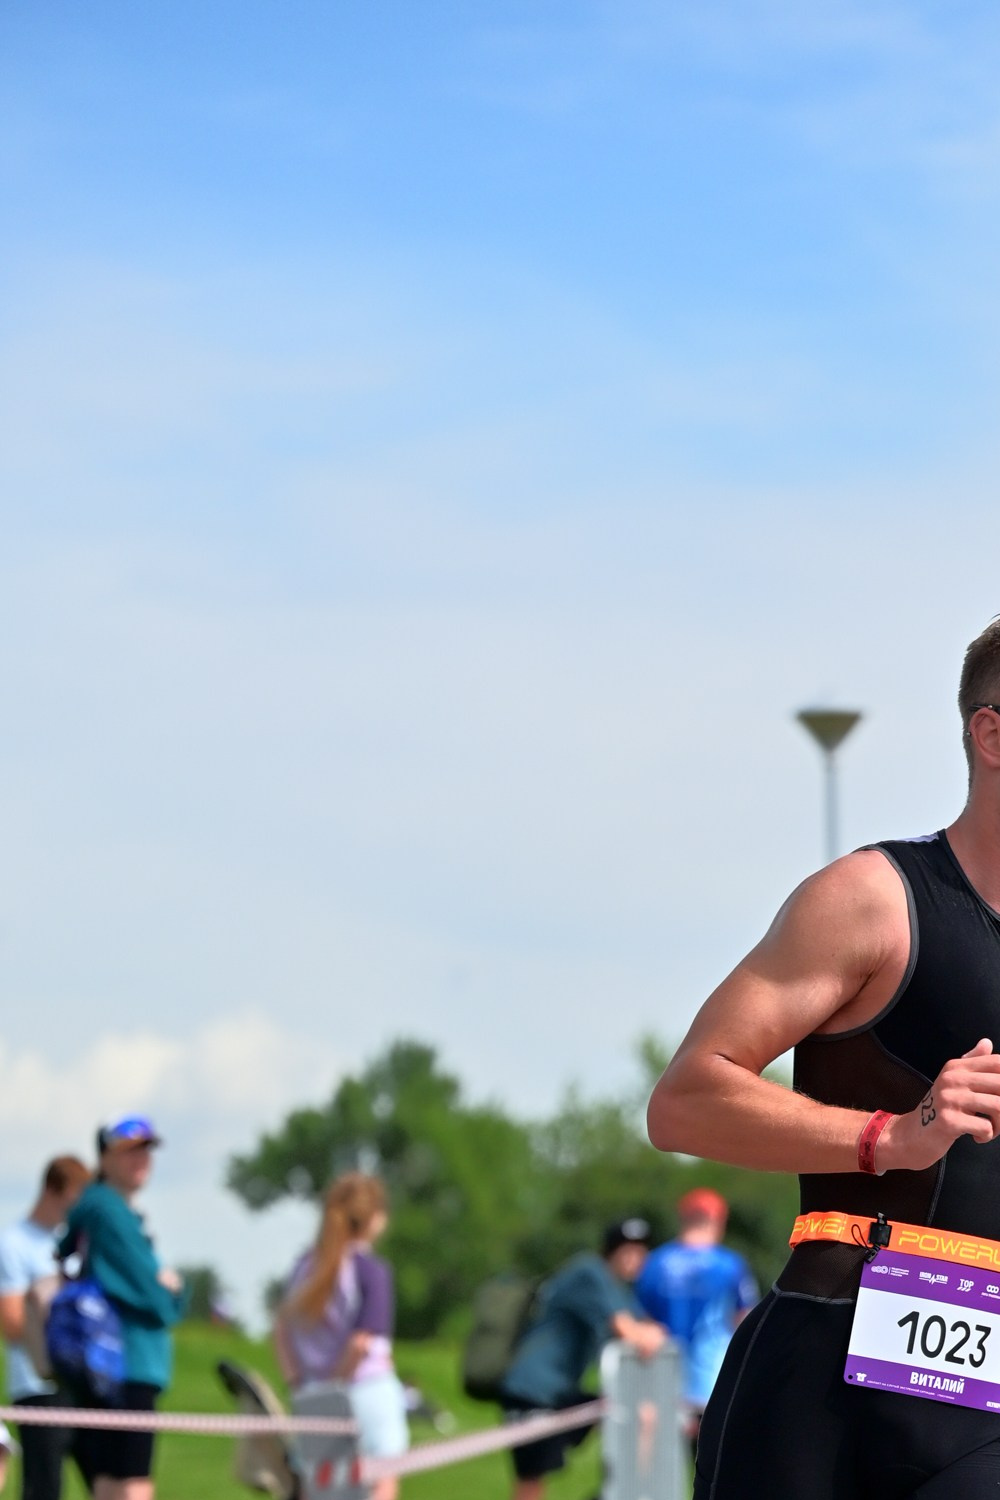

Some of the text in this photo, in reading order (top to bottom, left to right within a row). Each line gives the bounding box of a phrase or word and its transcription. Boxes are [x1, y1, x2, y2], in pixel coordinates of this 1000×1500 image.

[959, 1278, 975, 1288] TOP
[897, 1310, 991, 1368] 1023
[910, 1372, 965, 1394] ВИТАЛИЙ
